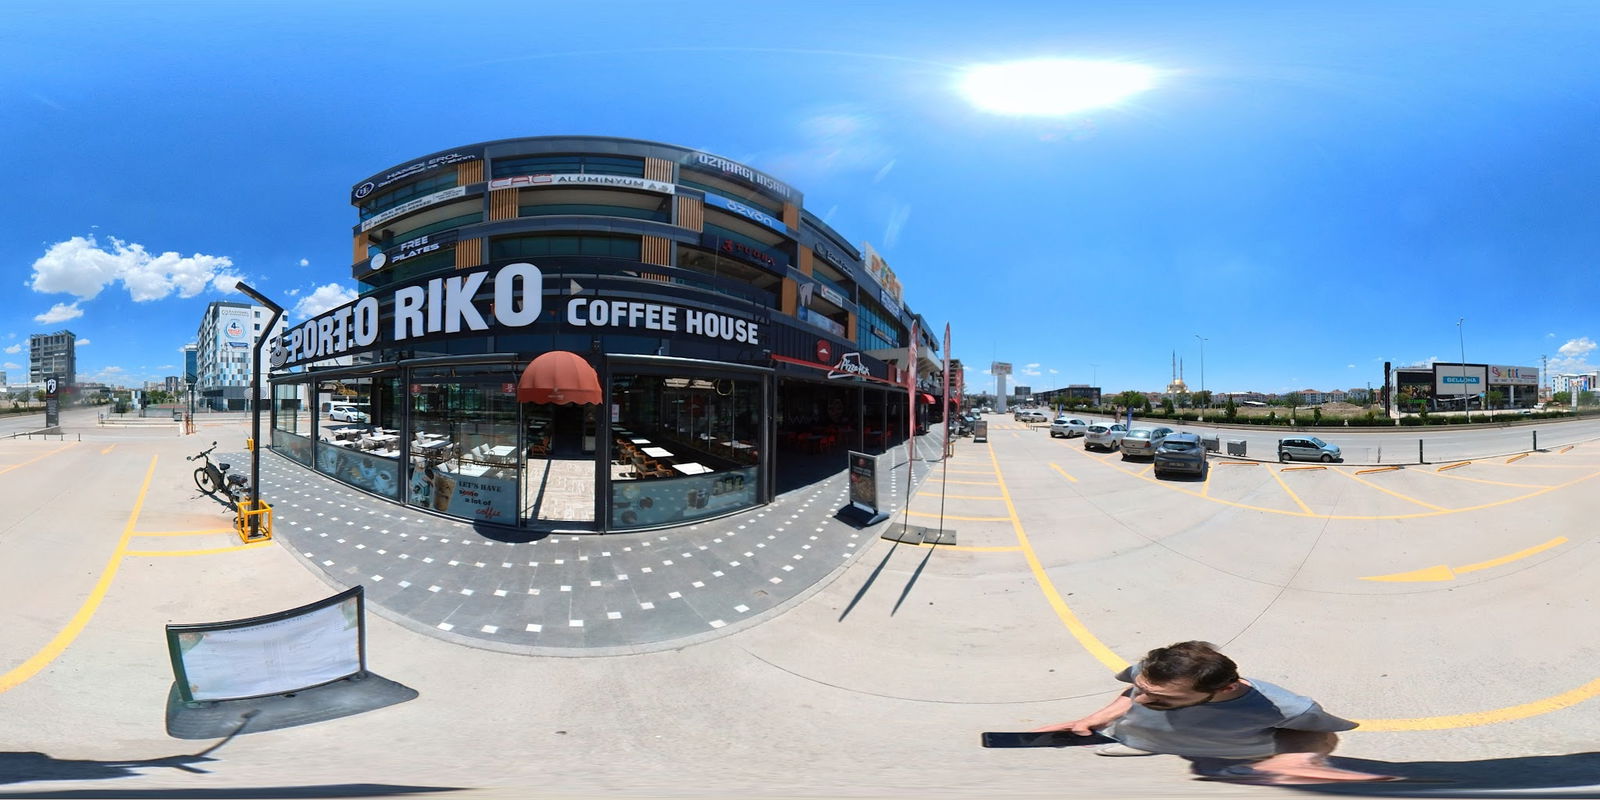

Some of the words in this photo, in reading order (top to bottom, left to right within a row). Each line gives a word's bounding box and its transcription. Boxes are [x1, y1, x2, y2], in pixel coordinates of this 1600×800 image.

[400, 235, 429, 251] FREE
[290, 295, 379, 363] PORTO
[394, 262, 543, 341] RIKO
[567, 298, 678, 332] COFFEE
[686, 308, 759, 345] HOUSE
[480, 483, 502, 492] HAVE
